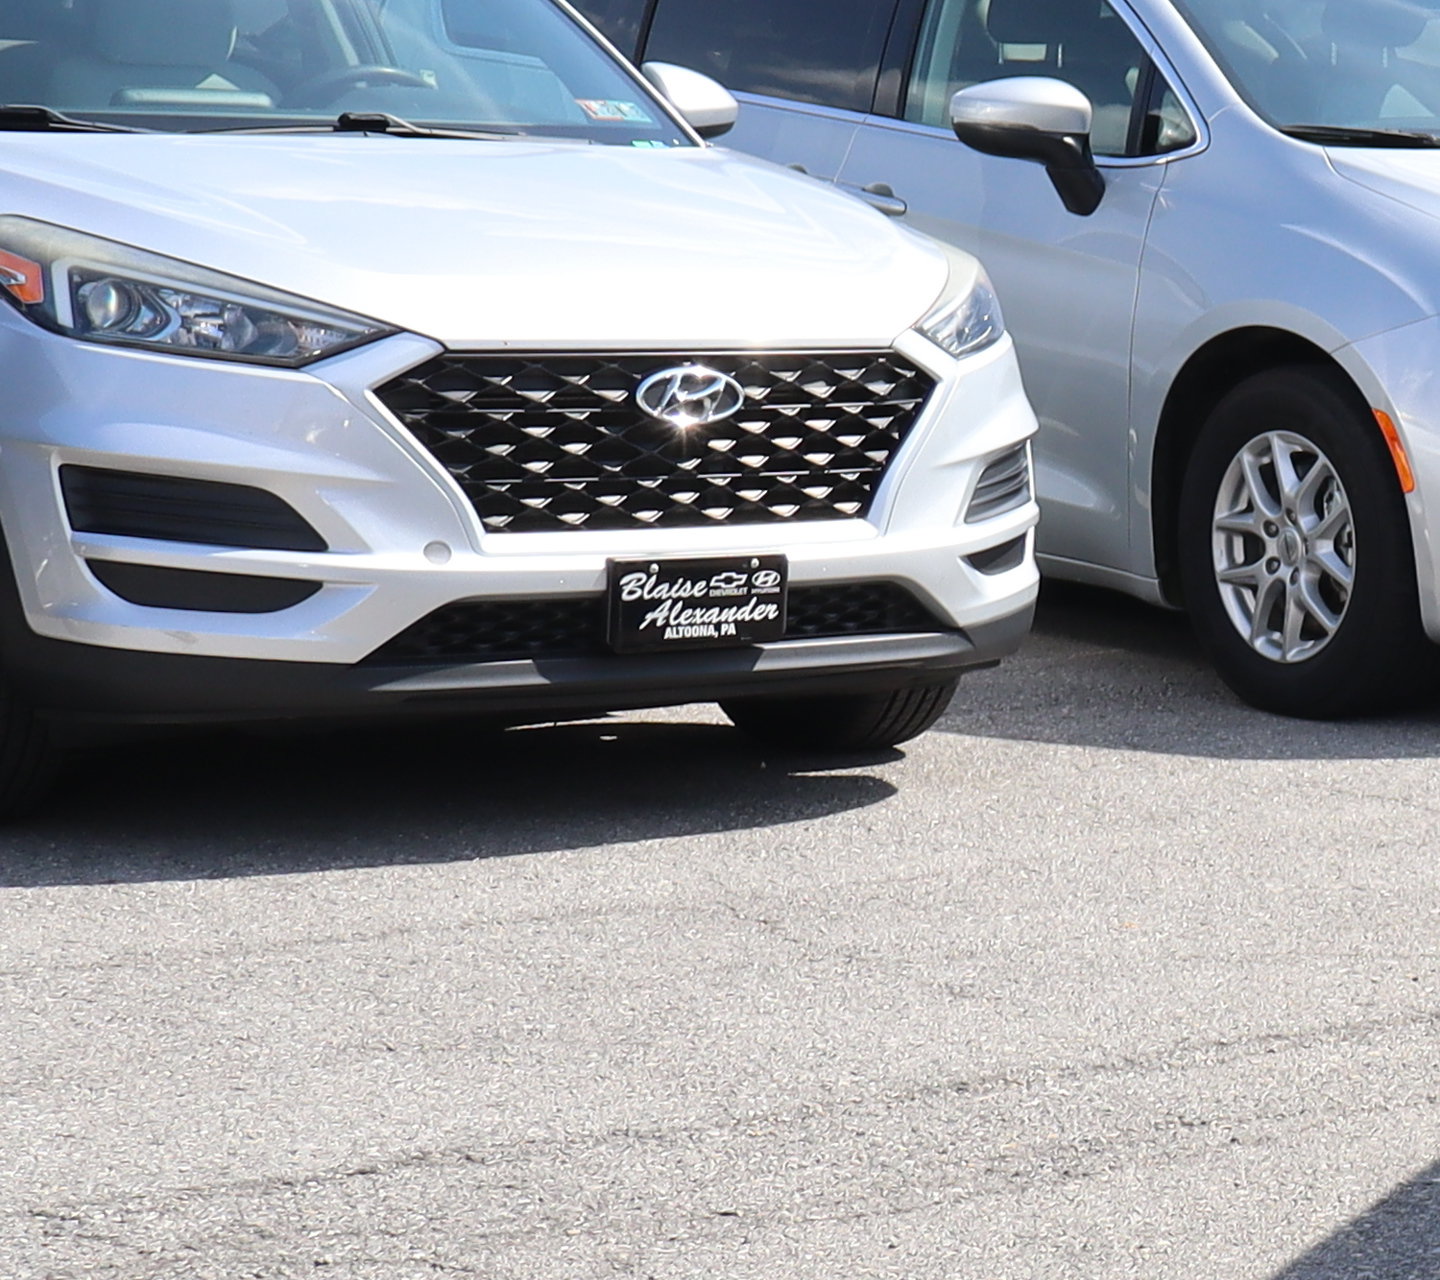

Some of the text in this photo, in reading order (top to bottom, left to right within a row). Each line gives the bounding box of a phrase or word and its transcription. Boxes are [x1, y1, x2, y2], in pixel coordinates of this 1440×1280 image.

[619, 572, 709, 601] Blaise
[639, 596, 779, 630] Alexander
[664, 622, 737, 639] ALTOONA, PA
